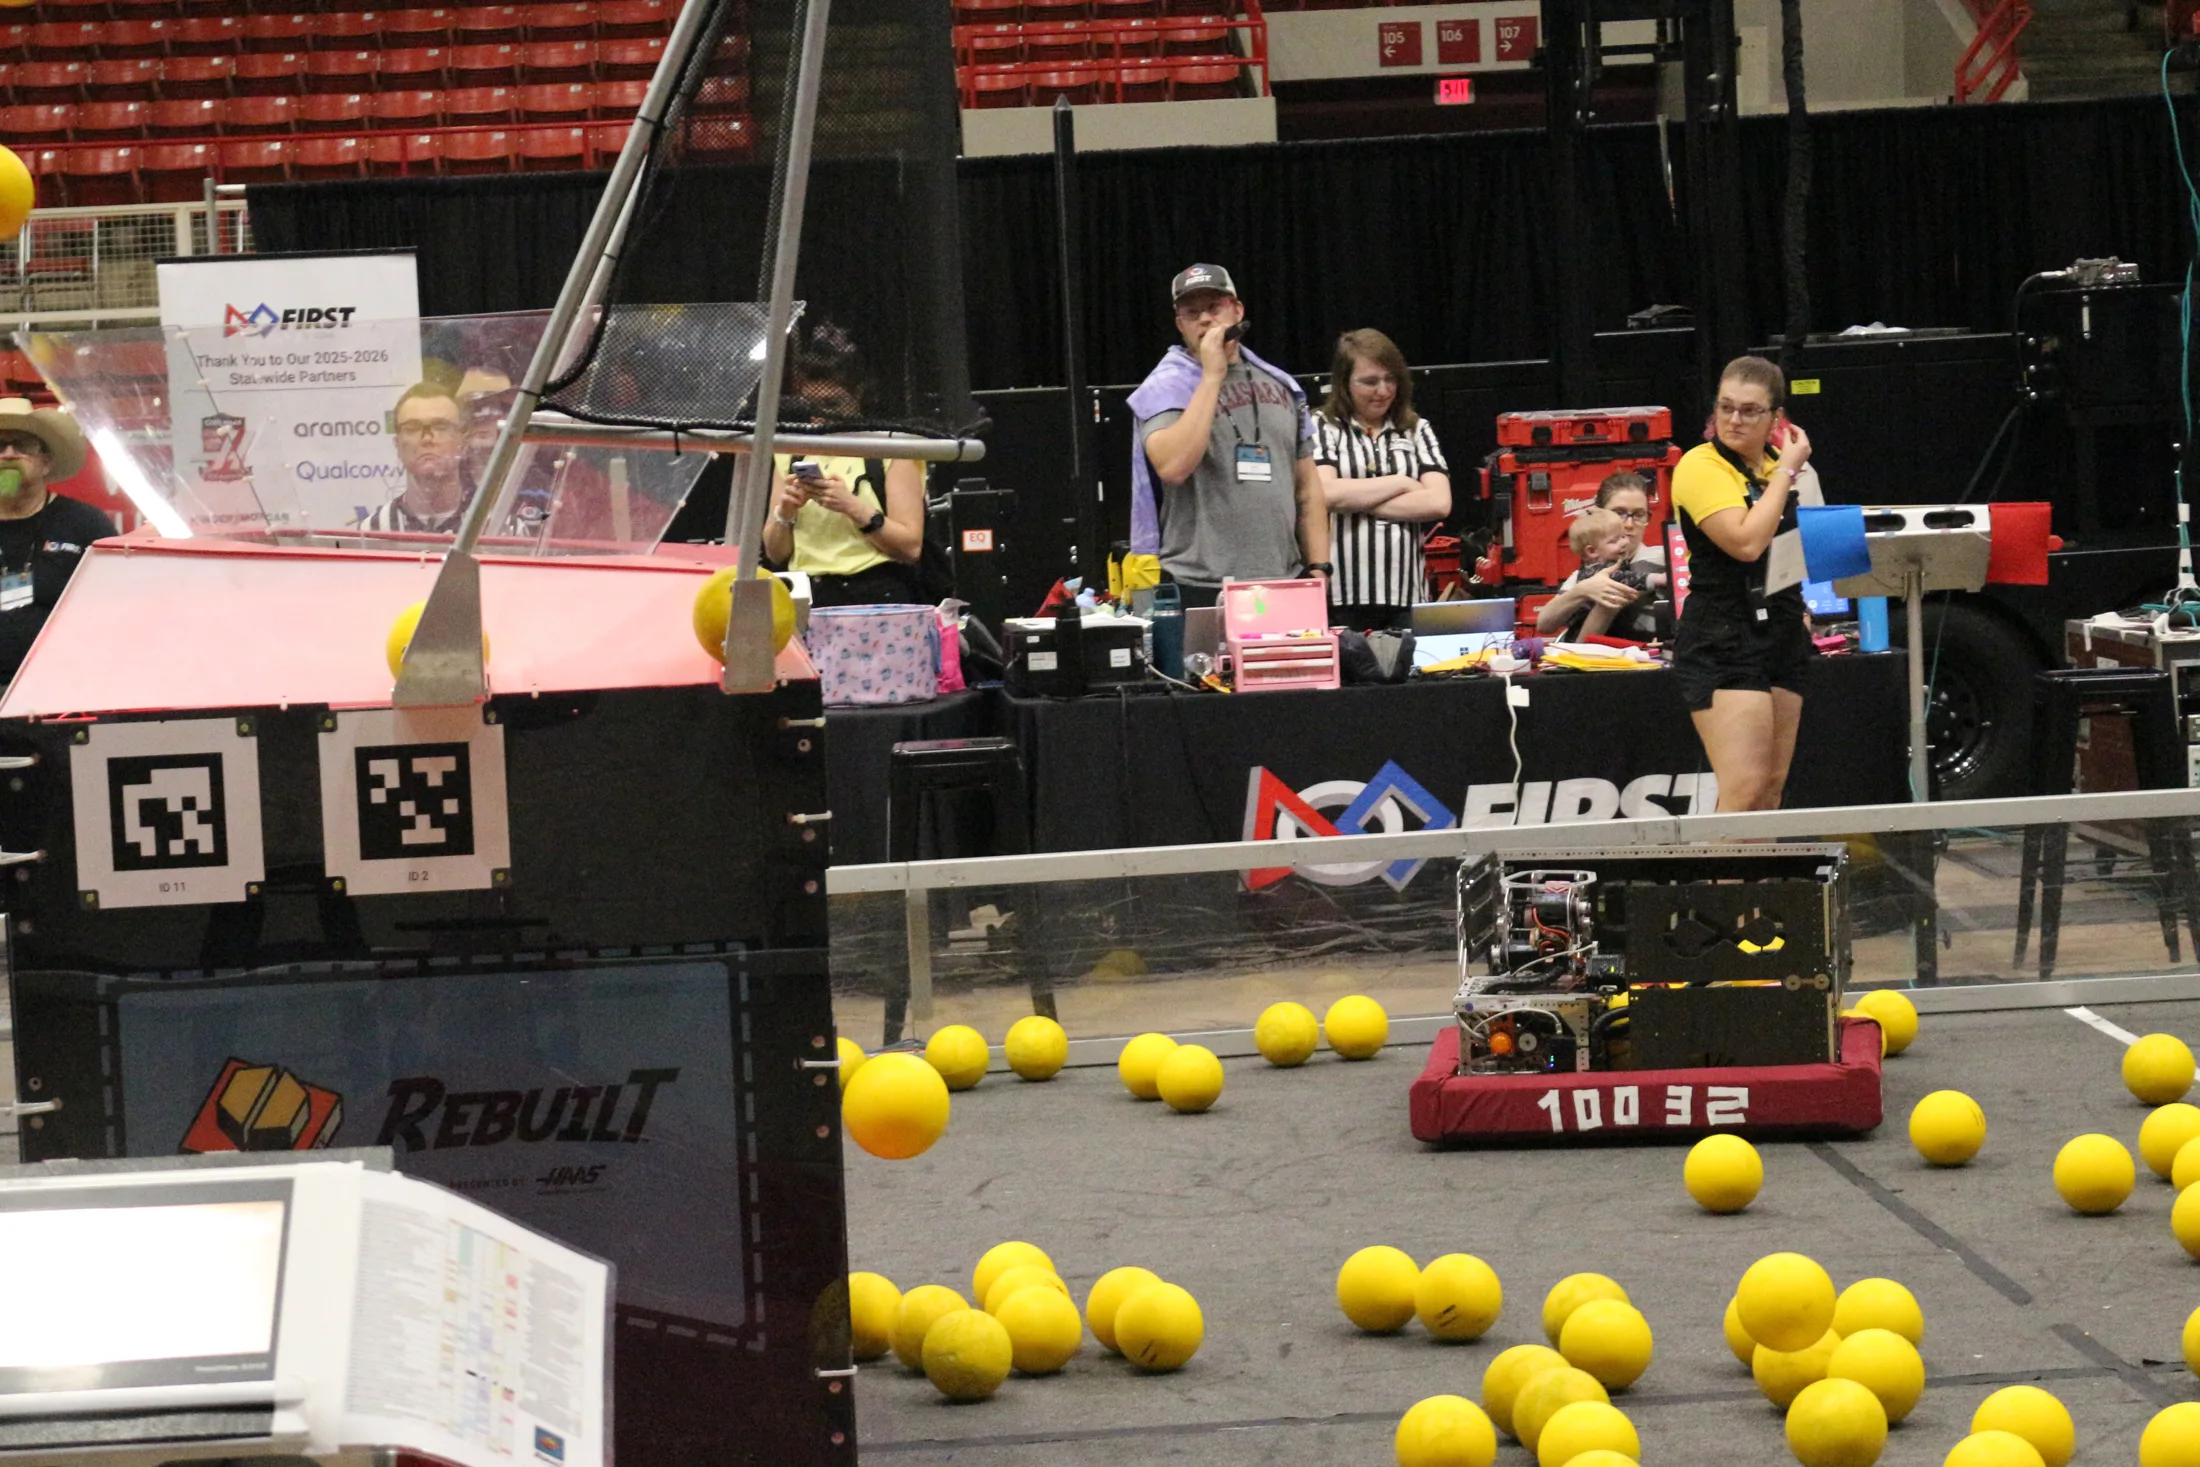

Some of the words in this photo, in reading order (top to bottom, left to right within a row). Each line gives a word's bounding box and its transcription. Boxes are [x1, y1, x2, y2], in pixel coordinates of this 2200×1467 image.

[1383, 31, 1405, 44] 105
[1441, 29, 1463, 42] 106
[1499, 26, 1521, 39] 107
[1440, 79, 1471, 103] EXIT
[280, 307, 356, 330] FIRST
[197, 355, 238, 368] Thank
[270, 353, 283, 366] to
[289, 352, 310, 365] Our
[315, 350, 389, 364] 2025-2026
[230, 370, 296, 386] Statwide
[300, 370, 357, 384] Partners
[294, 420, 381, 438] aramco
[970, 533, 986, 543] EQ
[408, 871, 420, 882] ID
[421, 870, 429, 881] 2
[159, 882, 171, 893] ID
[174, 881, 186, 892] 11
[376, 1067, 682, 1152] REBUILT
